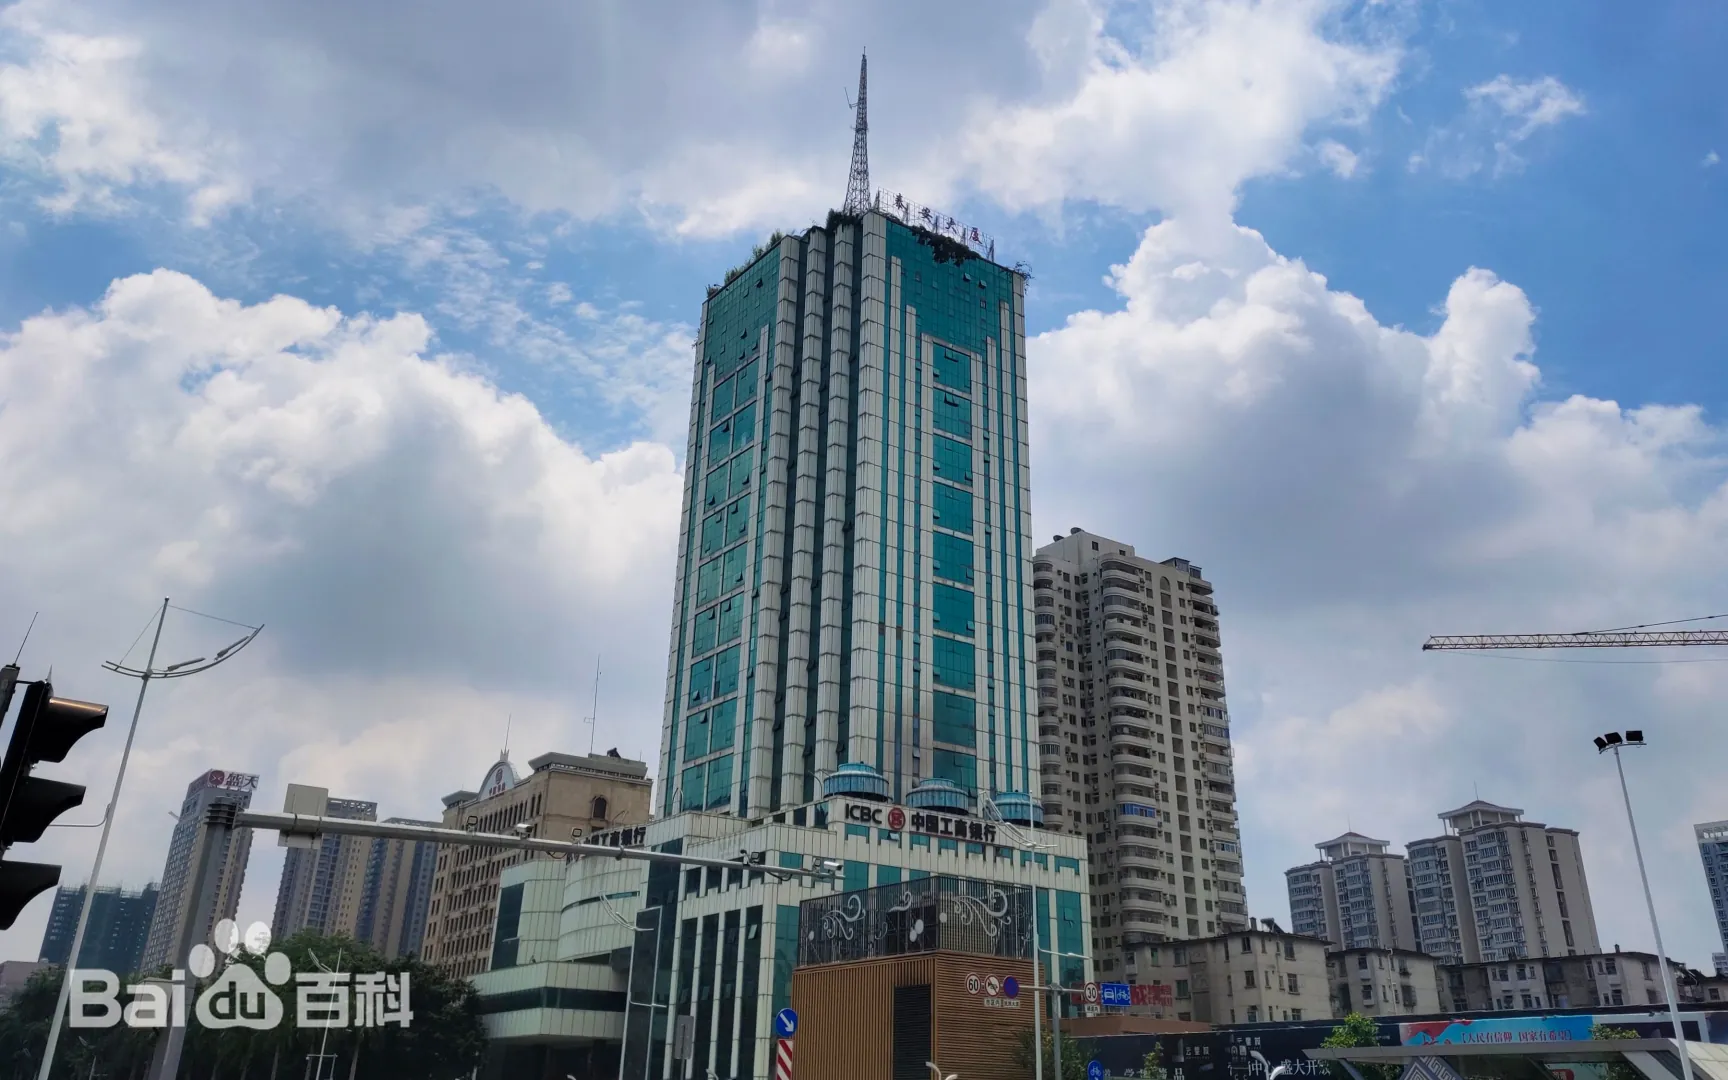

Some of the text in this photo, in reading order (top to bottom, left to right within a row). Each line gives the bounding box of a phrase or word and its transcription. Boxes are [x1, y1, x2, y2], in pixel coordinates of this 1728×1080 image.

[845, 803, 882, 824] ICBC
[968, 978, 979, 991] 60
[1087, 987, 1096, 999] 30
